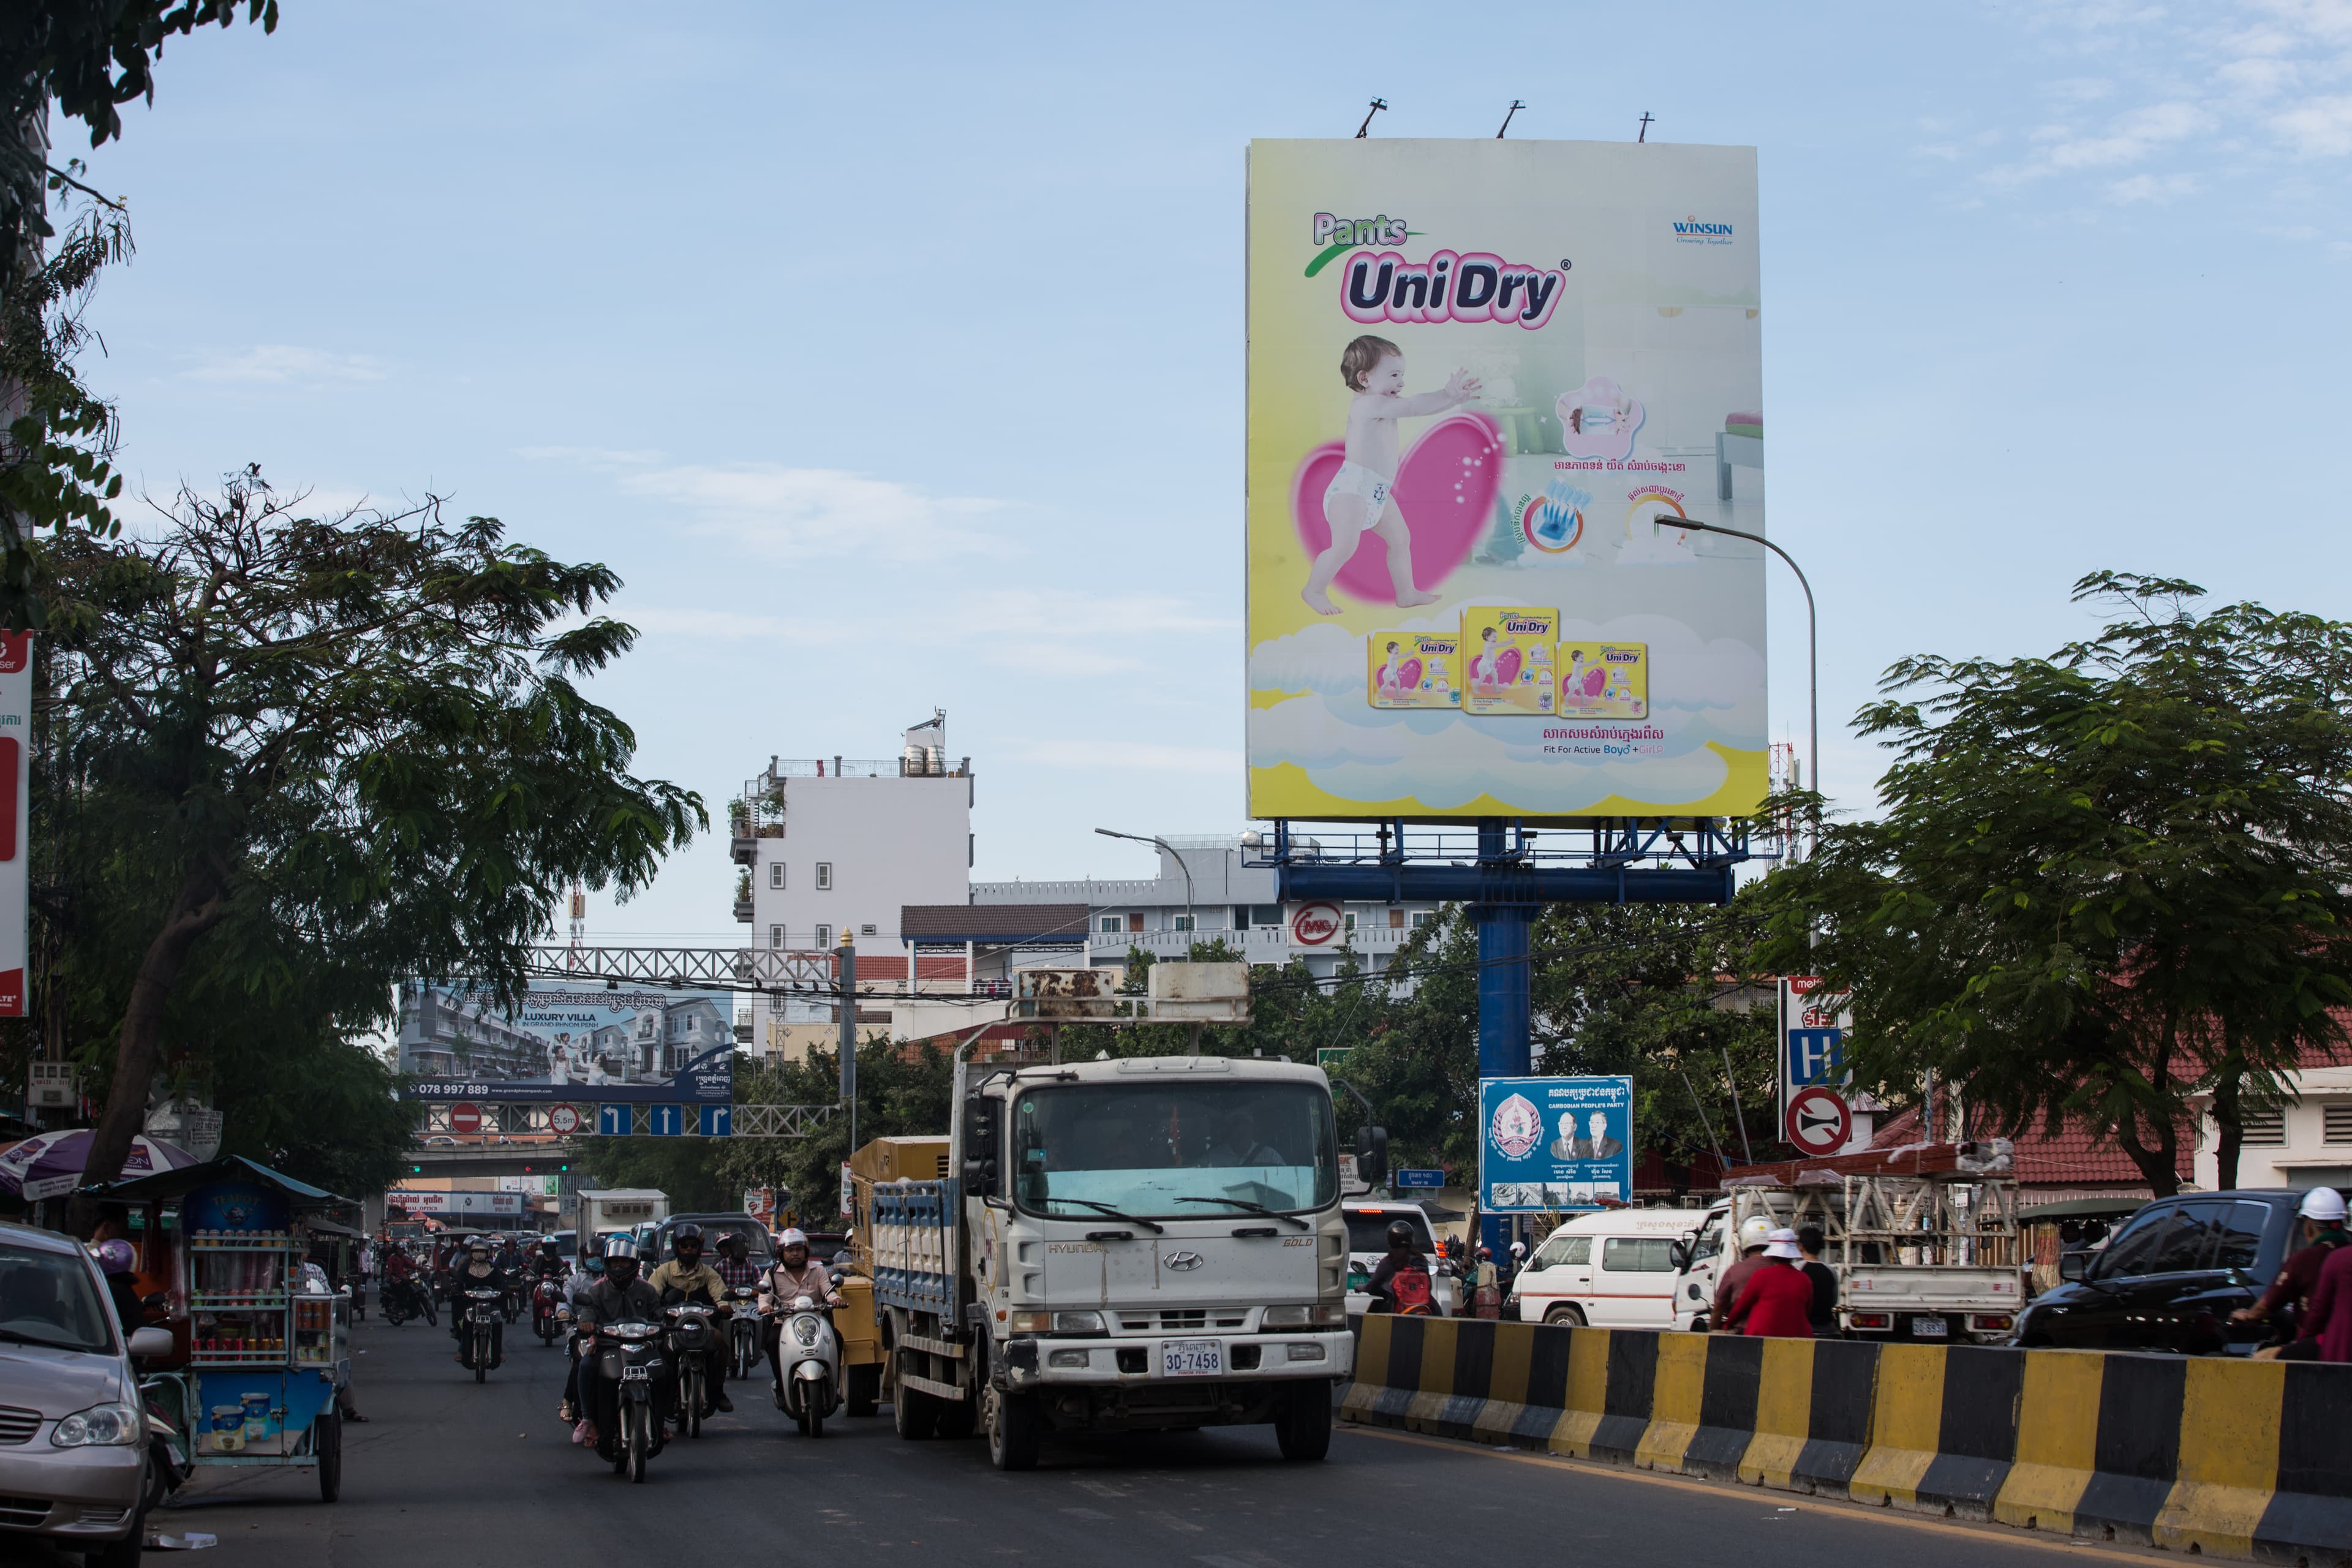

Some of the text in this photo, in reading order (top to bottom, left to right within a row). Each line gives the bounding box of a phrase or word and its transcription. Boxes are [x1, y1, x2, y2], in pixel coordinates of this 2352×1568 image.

[1314, 213, 1408, 246] Pants
[1673, 221, 1733, 236] WINSUN
[1676, 236, 1734, 246] Growing Together
[1544, 745, 1555, 754] Fit
[1558, 745, 1571, 754] For
[1574, 745, 1601, 754] Active
[567, 1013, 596, 1022] VILLA
[419, 1084, 489, 1095] 078 997 889
[1282, 1237, 1313, 1247] GOLD
[1049, 1243, 1107, 1254] HYUNDAI
[1166, 1353, 1218, 1370] 3D-7458
